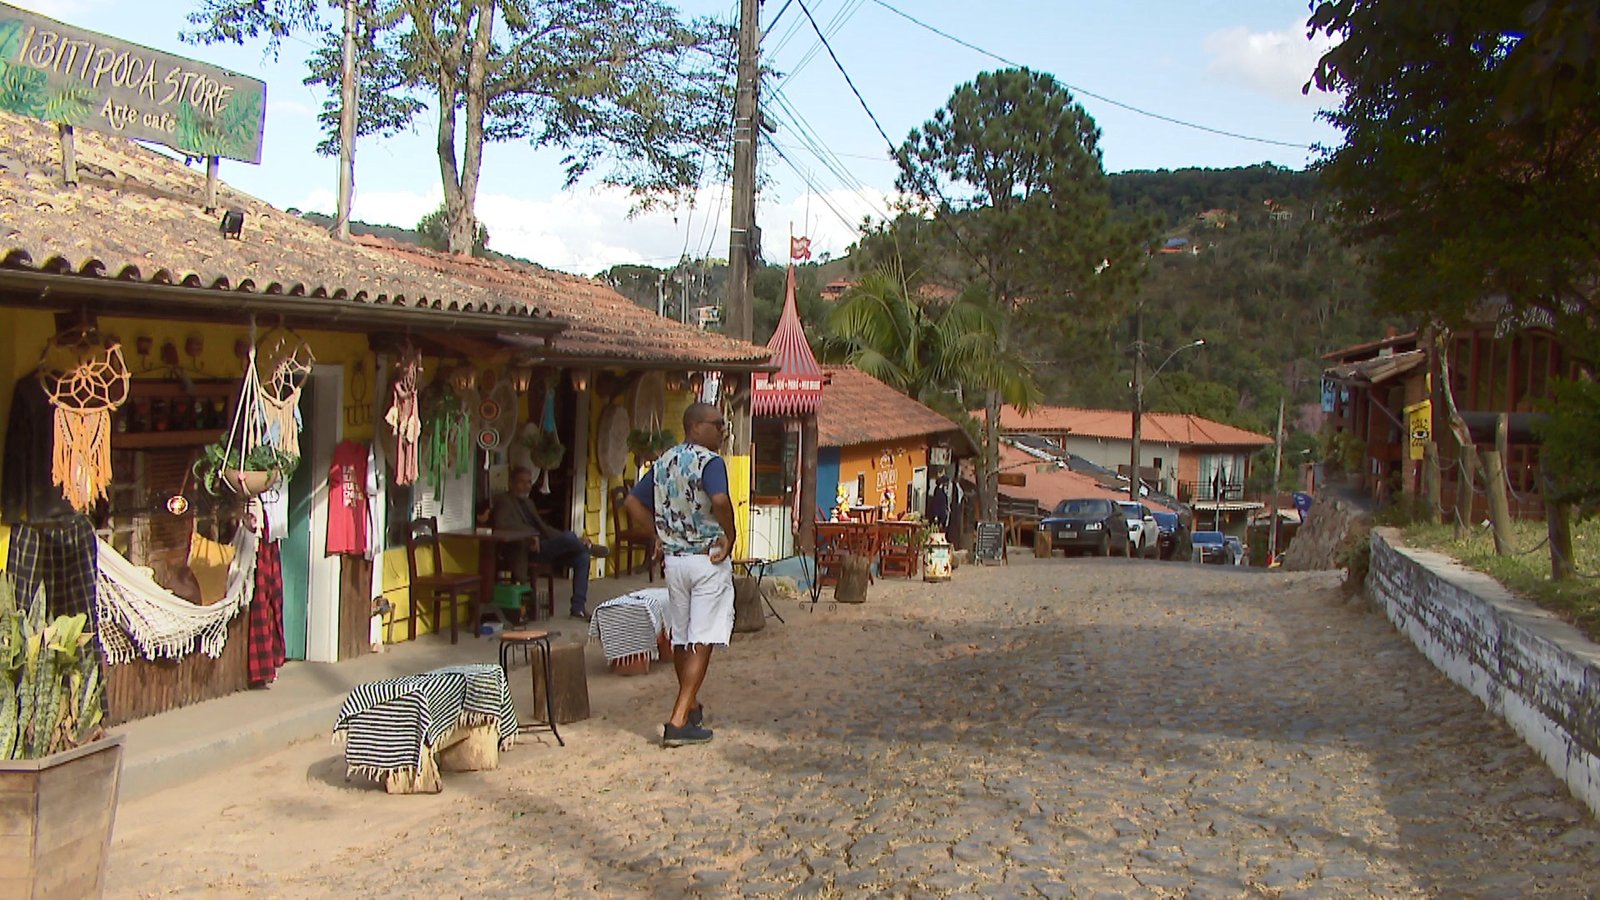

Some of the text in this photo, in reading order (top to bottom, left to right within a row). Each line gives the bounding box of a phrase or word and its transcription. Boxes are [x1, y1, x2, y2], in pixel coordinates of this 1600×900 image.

[19, 26, 234, 118] IBITIPOCA STORE
[100, 98, 138, 131] Arte
